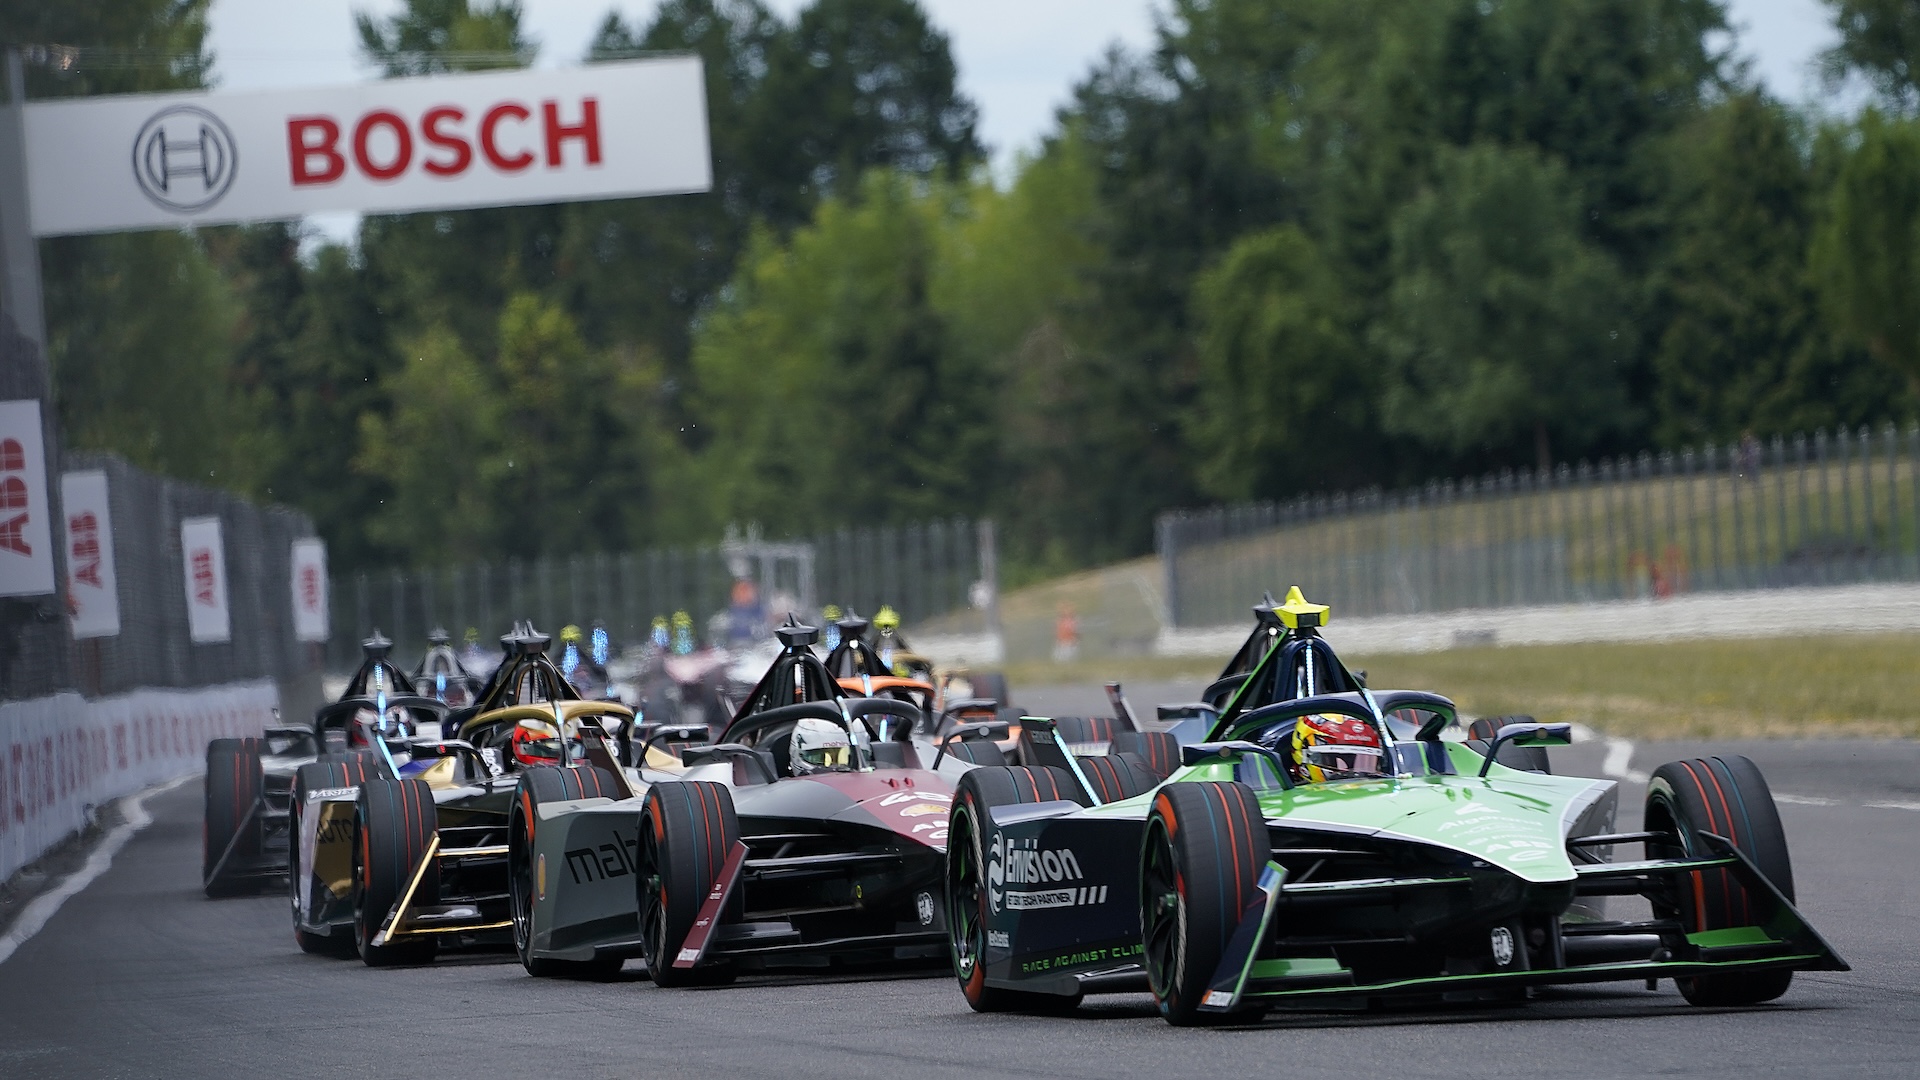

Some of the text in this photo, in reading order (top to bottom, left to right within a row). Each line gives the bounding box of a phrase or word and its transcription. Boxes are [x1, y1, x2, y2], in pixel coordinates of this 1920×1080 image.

[288, 97, 603, 186] BOSCH
[69, 512, 102, 589] ABB
[1006, 838, 1083, 883] Envision
[1037, 892, 1072, 905] PARTNER
[1022, 960, 1050, 973] RACE
[1053, 949, 1107, 967] AGAINST
